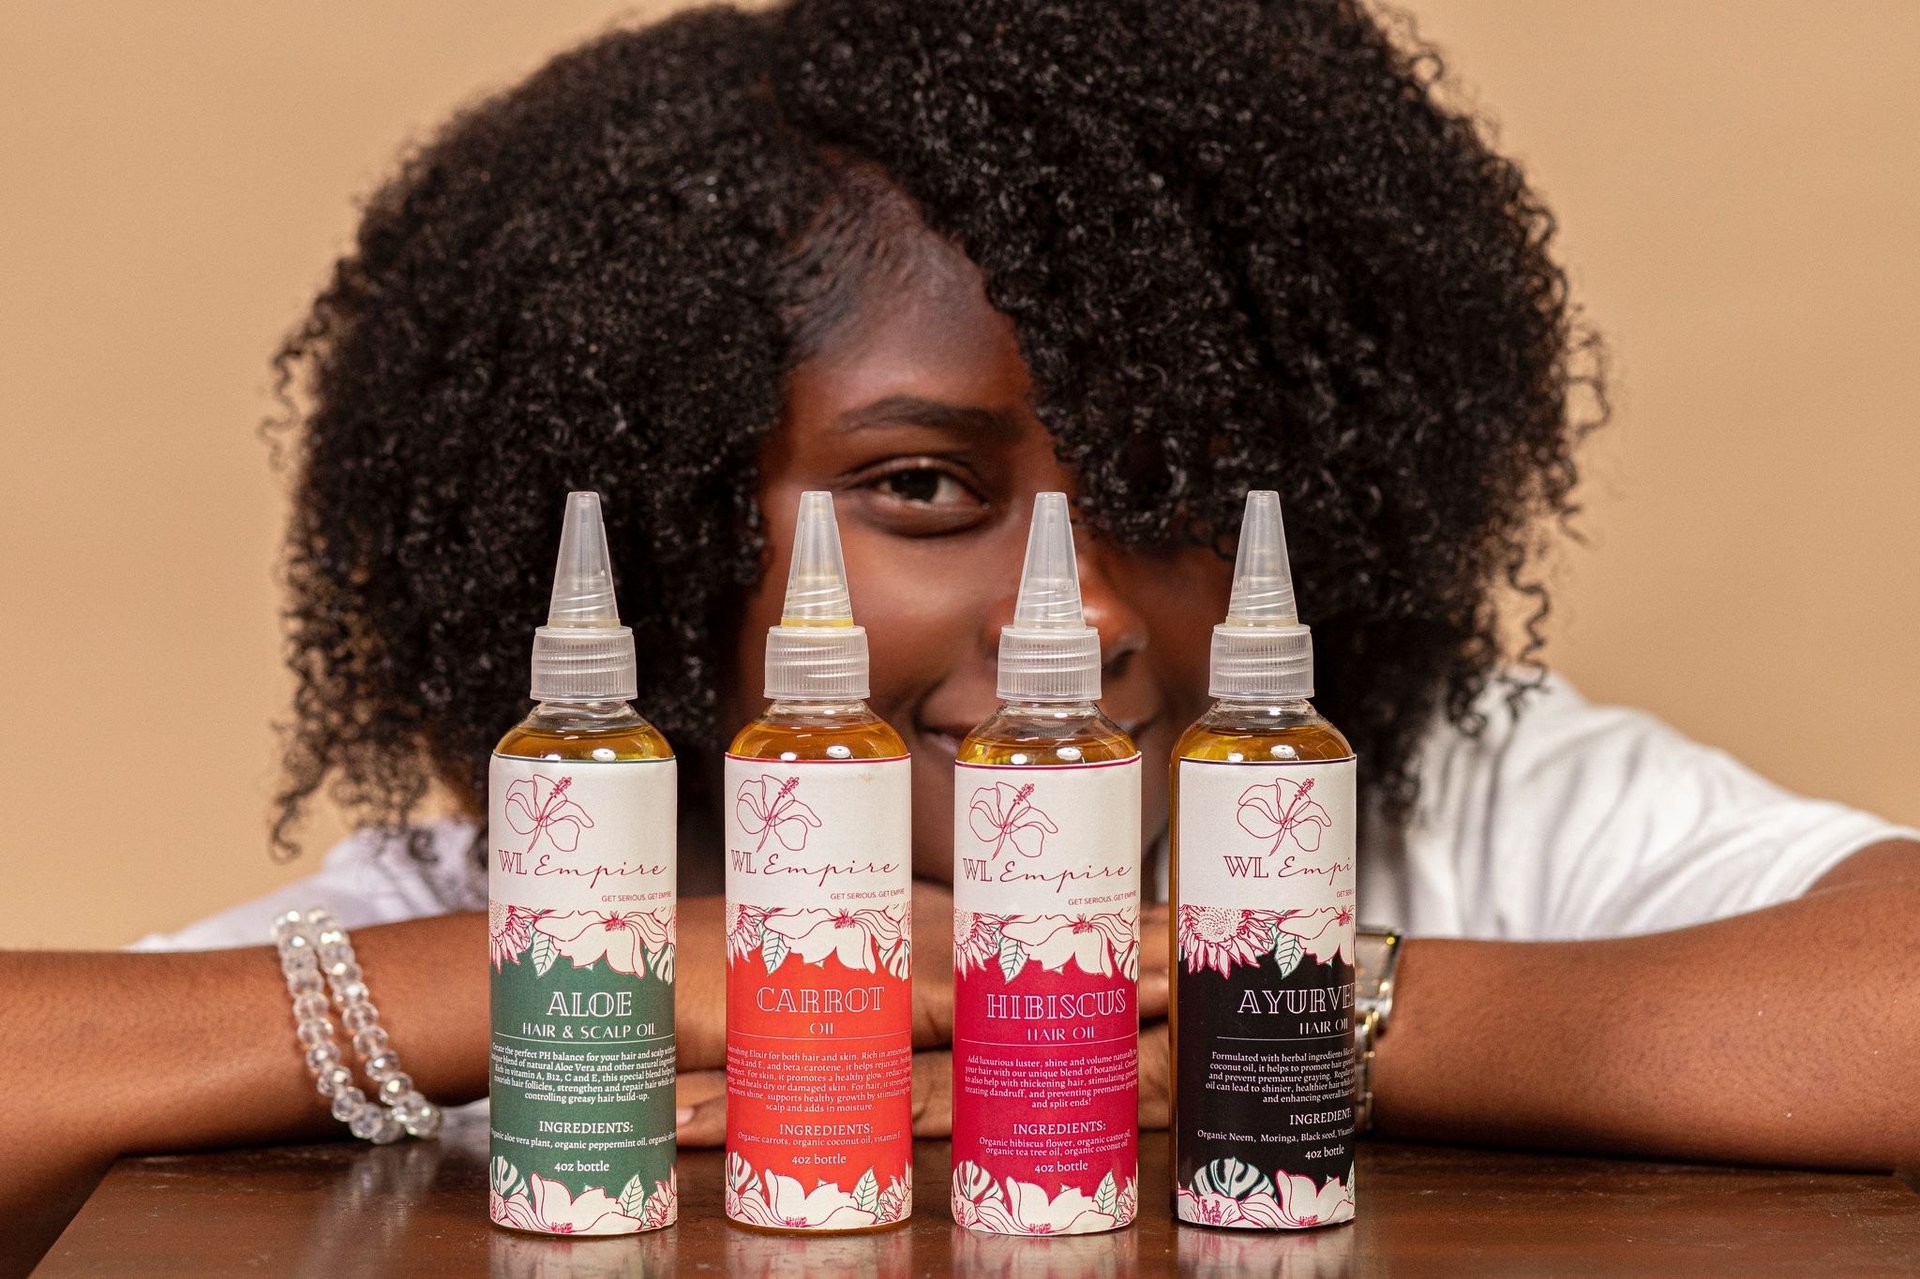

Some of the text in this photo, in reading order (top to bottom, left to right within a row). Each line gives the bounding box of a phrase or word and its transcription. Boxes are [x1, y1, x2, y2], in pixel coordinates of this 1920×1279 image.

[499, 850, 667, 889] WL Empire
[731, 850, 899, 887] WL Empire
[1224, 856, 1269, 878] WL
[963, 858, 1132, 893] WL Empire
[602, 894, 616, 902] GET
[648, 892, 658, 900] GET
[878, 890, 890, 898] GET
[1068, 898, 1082, 906] GET
[1114, 894, 1124, 902] GET
[546, 991, 632, 1018] ALOE
[756, 986, 884, 1013] CARROT
[986, 988, 1126, 1020] HIBISCUS
[523, 1022, 656, 1039] HAIR & SCALP OIL
[1028, 1028, 1066, 1041] HAIR
[1300, 1022, 1330, 1035] HAIR
[514, 1049, 650, 1064] perfect PH balance for your hair and
[750, 1050, 767, 1058] Elixir
[768, 1050, 780, 1060] for
[782, 1052, 800, 1060] both
[802, 1054, 819, 1062] hair
[822, 1053, 837, 1061] and
[862, 1050, 878, 1060] Rich
[980, 1056, 1014, 1066] luxurious
[1045, 1059, 1068, 1067] shine
[1070, 1057, 1084, 1066] and
[1086, 1056, 1112, 1064] volume
[1212, 1052, 1258, 1062] Formulated
[1260, 1054, 1280, 1062] with
[1282, 1053, 1306, 1062] herbal
[1308, 1051, 1342, 1062] ingredients
[527, 1062, 553, 1070] natural
[554, 1062, 573, 1071] Aloe
[575, 1064, 594, 1072] Vera
[597, 1063, 612, 1071] and
[614, 1062, 635, 1070] other
[636, 1058, 658, 1070] natural
[767, 1062, 874, 1071] and helps
[1210, 1063, 1330, 1074] coconut oil, helps promote
[511, 1068, 661, 1082] vitamin B12, and this special blend
[836, 1073, 864, 1082] healthy
[978, 1066, 992, 1075] hair
[993, 1068, 1010, 1076] with
[1028, 1070, 1058, 1079] unique
[1060, 1068, 1082, 1076] blend
[1208, 1072, 1302, 1084] and prevent premature
[512, 1078, 656, 1094] hair follicles, strengthen and repair hair
[746, 1080, 762, 1088] heals
[763, 1082, 774, 1090] dry
[788, 1084, 826, 1094] damaged
[971, 1076, 983, 1084] also
[984, 1077, 999, 1088] help
[1020, 1080, 1065, 1088] thickening
[1088, 1073, 1124, 1085] stimulating
[1029, 1090, 1045, 1098] and
[1048, 1089, 1092, 1099] preventing
[1093, 1084, 1125, 1096] premature
[1232, 1083, 1249, 1092] lead
[1262, 1084, 1294, 1092] shinier,
[1296, 1083, 1328, 1092] healthier
[525, 1092, 650, 1104] controlling greasy hair build-up.
[768, 1094, 865, 1103] supports healthy growth
[1032, 1100, 1068, 1109] and split
[1263, 1094, 1321, 1102] and enhancing
[766, 1104, 784, 1112] scalp
[787, 1104, 802, 1112] and
[540, 1121, 634, 1134] INGREDIENTS:
[780, 1124, 873, 1136] INGREDIENTS:
[1013, 1120, 1106, 1134] INGREDIENTS:
[516, 1136, 636, 1150] vera plant, organic peppermint
[762, 1136, 872, 1148] carrots, organic coconut oil,
[980, 1136, 1104, 1148] Organic hibiscus organic
[1198, 1130, 1320, 1144] Organic Neem, Moringa, Black
[986, 1148, 1014, 1156] organic
[1049, 1148, 1062, 1156] oil,
[1064, 1147, 1094, 1156] organic
[1096, 1143, 1120, 1152] coconut
[1305, 1144, 1344, 1160] 4oz bottle
[792, 1154, 846, 1164] 4oz bottle
[554, 1160, 610, 1172] 4oz bottle
[1034, 1160, 1088, 1173] 4oz bottle
